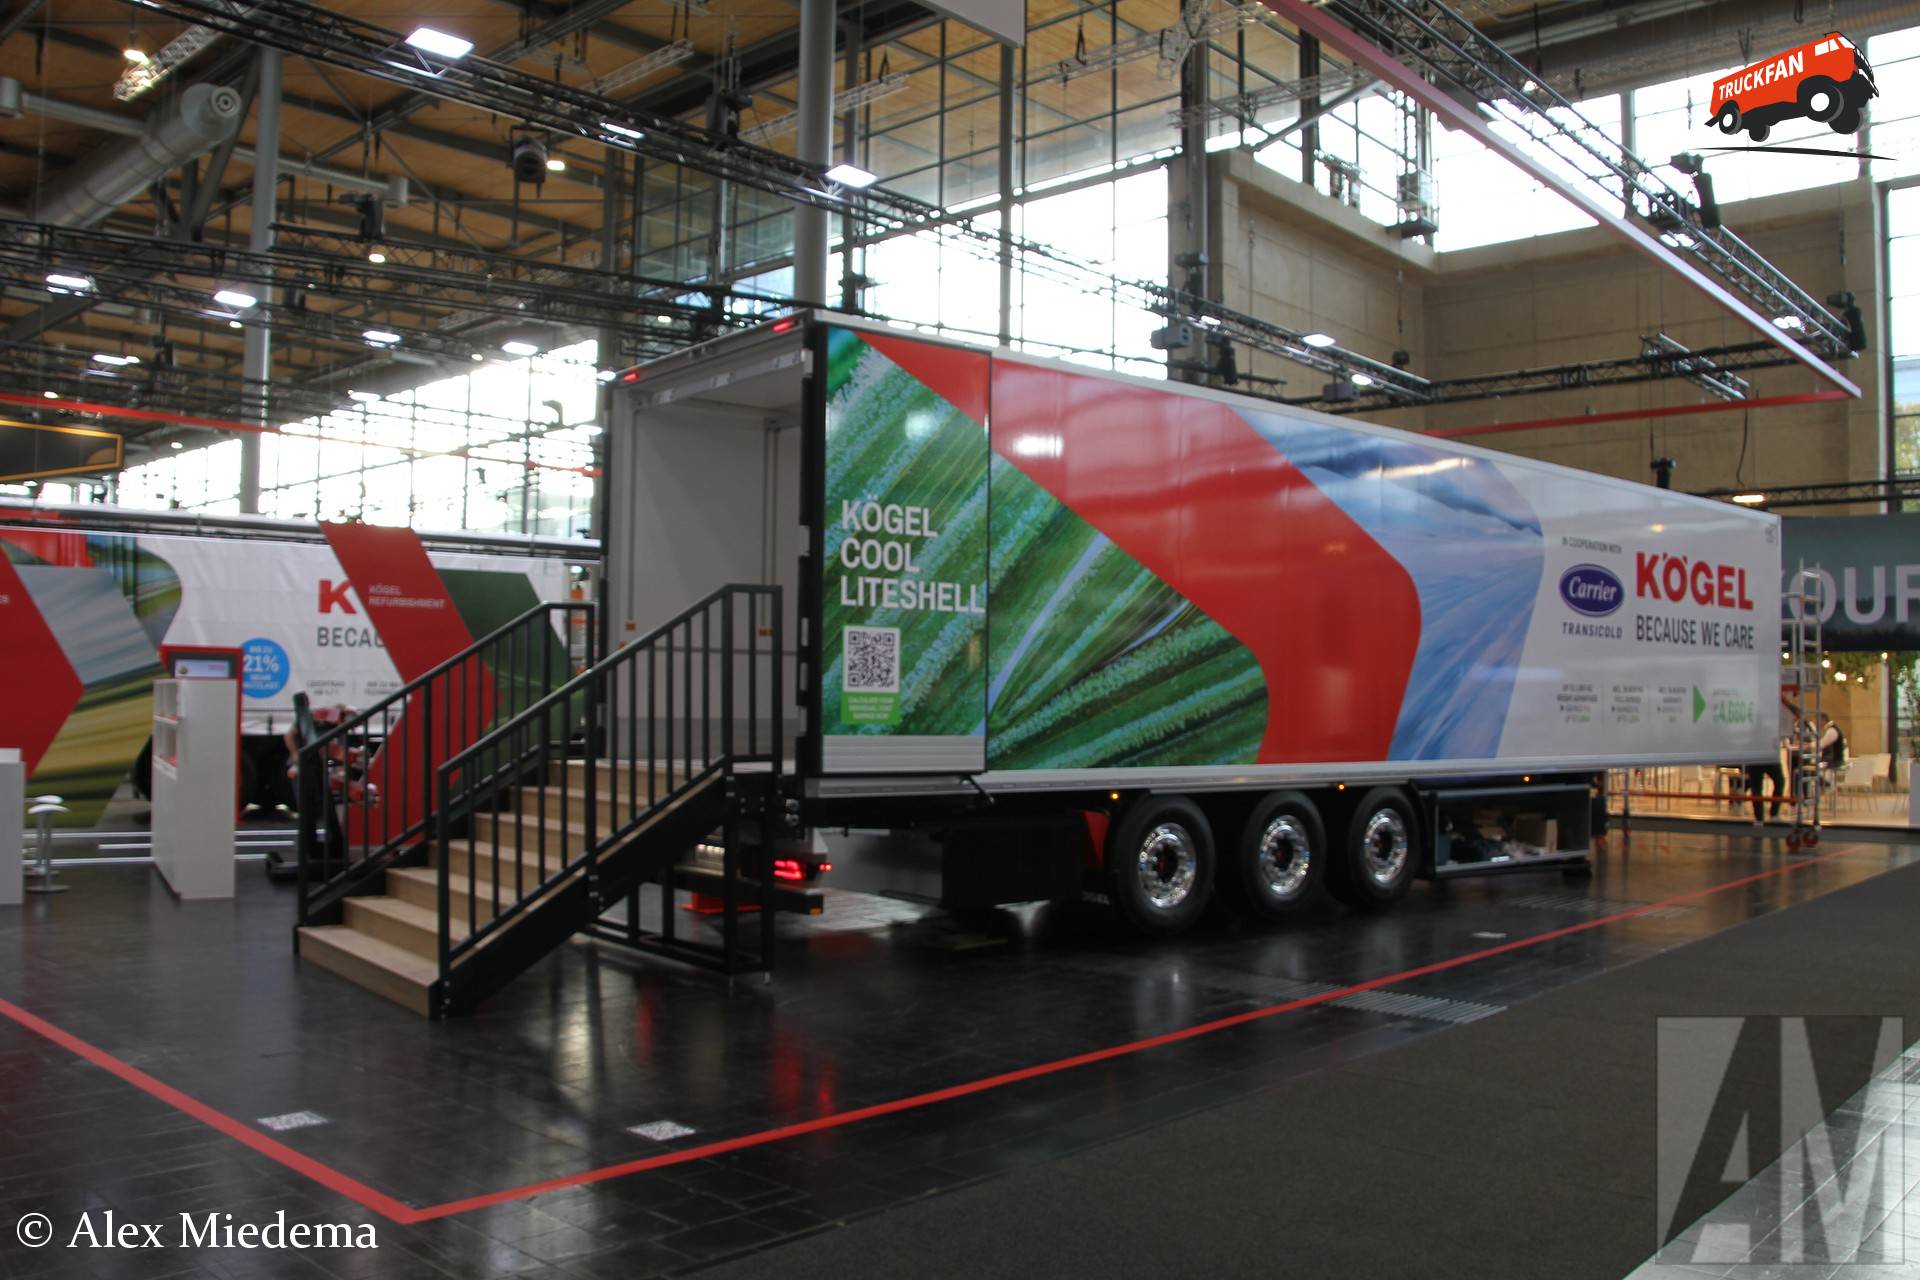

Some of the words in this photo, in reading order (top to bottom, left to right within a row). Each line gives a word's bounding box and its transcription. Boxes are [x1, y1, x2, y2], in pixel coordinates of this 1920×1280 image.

[841, 494, 938, 537] KÖGEL
[841, 538, 920, 573] COOL
[840, 575, 986, 613] LITESHELL
[1569, 575, 1617, 602] Carrier
[1636, 551, 1754, 611] KÖGEL
[368, 595, 445, 609] REFURBISHMENT
[1562, 622, 1623, 639] TRANSICOLD
[1636, 614, 1697, 645] BECAUSE
[1701, 619, 1721, 647] WE
[1724, 623, 1754, 649] CARE
[243, 655, 279, 672] 21%
